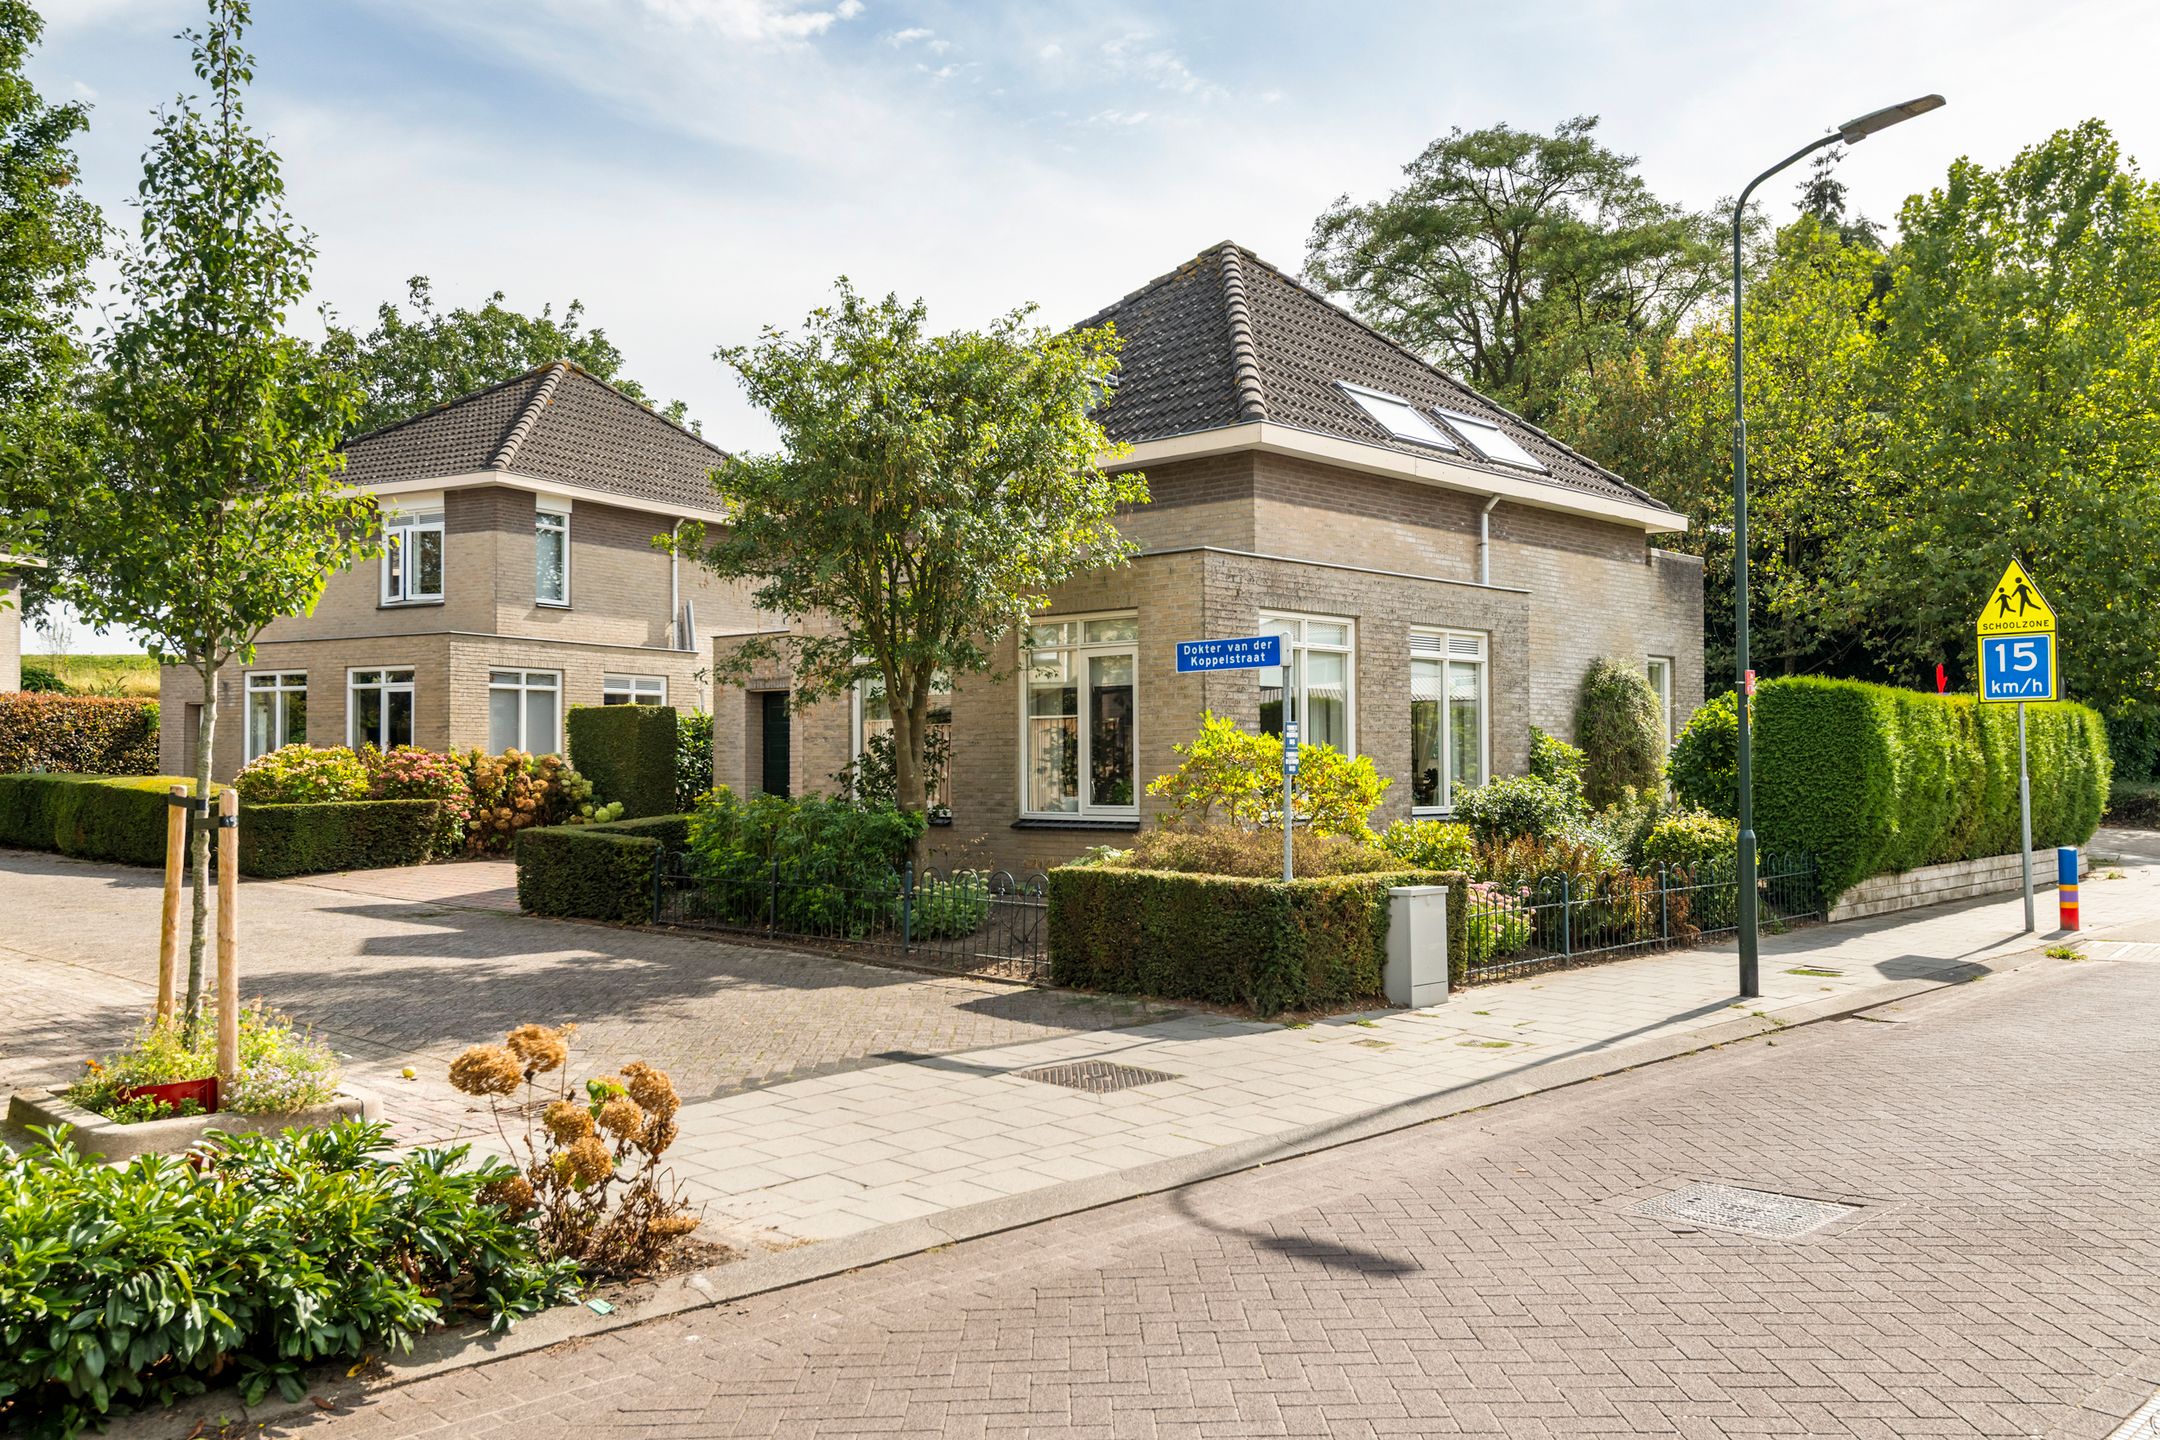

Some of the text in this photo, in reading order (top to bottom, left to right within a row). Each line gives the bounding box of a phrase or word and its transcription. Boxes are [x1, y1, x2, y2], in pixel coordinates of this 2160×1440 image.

[1982, 620, 2049, 630] SCHOOLZONE
[1183, 640, 1273, 655] Dokter van der
[1191, 652, 1265, 667] Koppelstraat
[1995, 642, 2038, 673] 15
[1991, 678, 2043, 694] km/h
